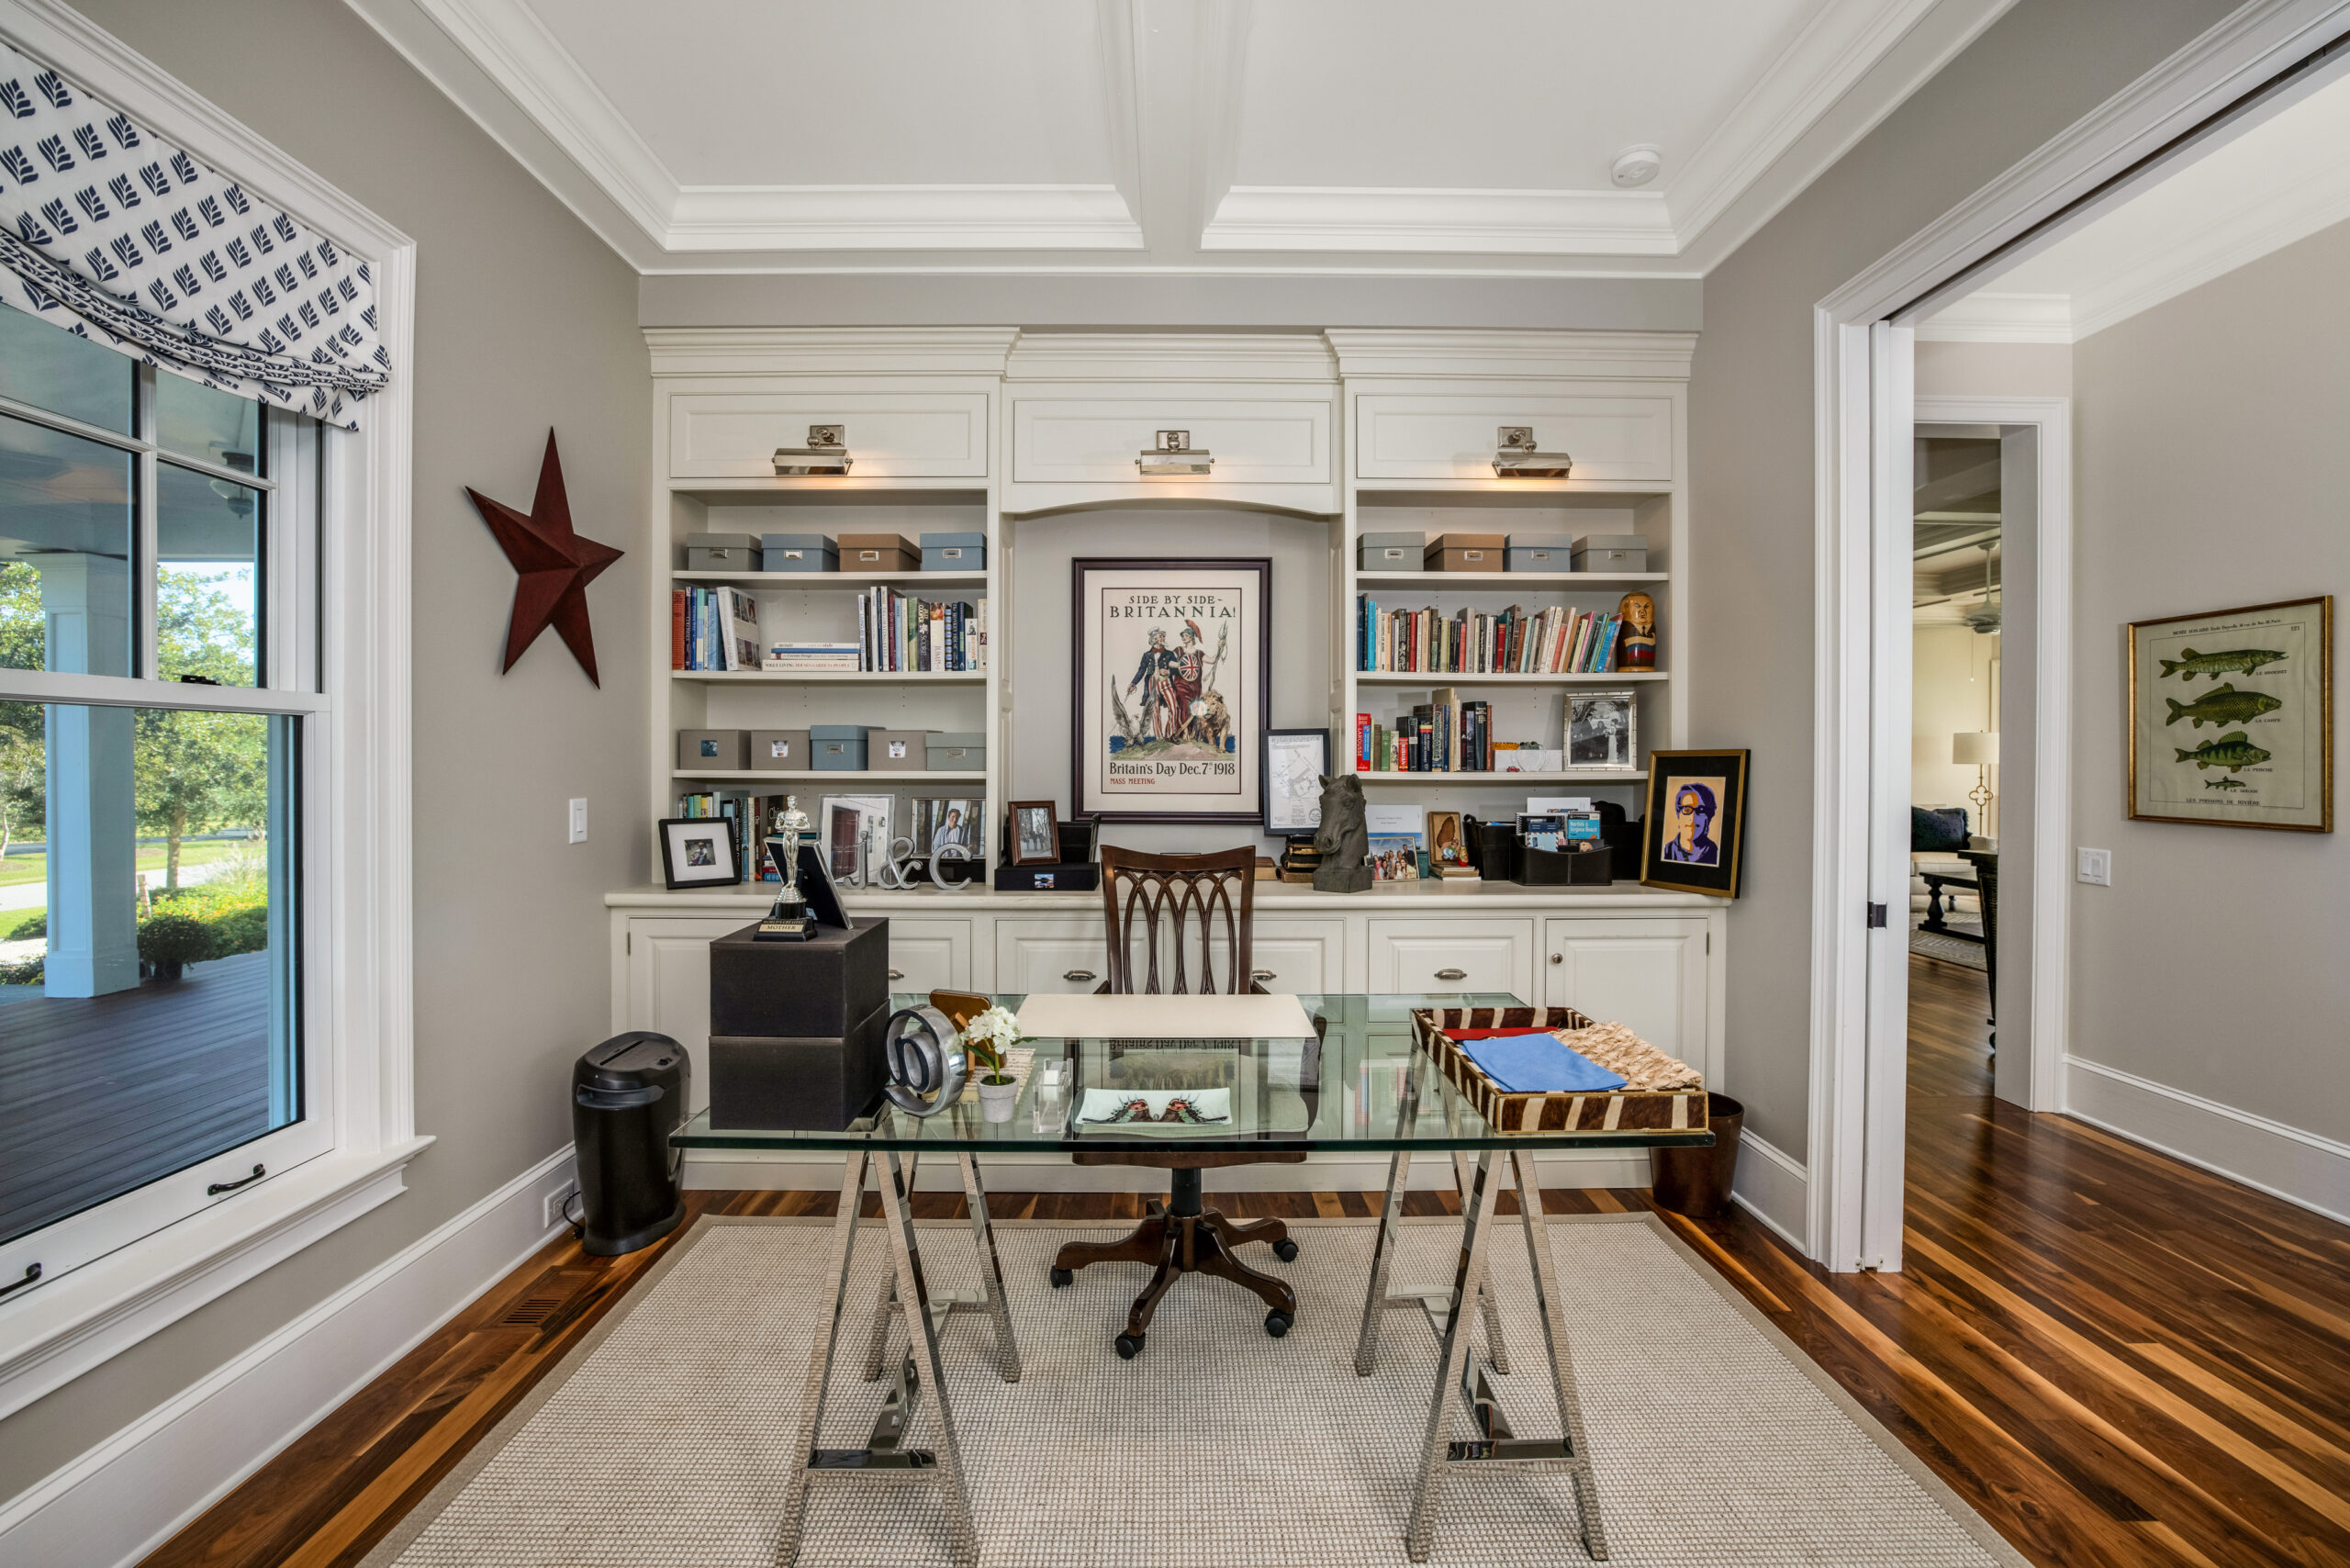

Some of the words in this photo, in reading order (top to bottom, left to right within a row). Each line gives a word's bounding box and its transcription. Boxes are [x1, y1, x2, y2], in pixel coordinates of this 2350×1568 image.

[1129, 595, 1158, 604] SIDE
[1164, 595, 1181, 604] BY
[1110, 606, 1236, 618] BRITANNIA!
[1110, 762, 1153, 775] Britain's
[1156, 762, 1176, 776] Day
[1214, 762, 1235, 775] 1918
